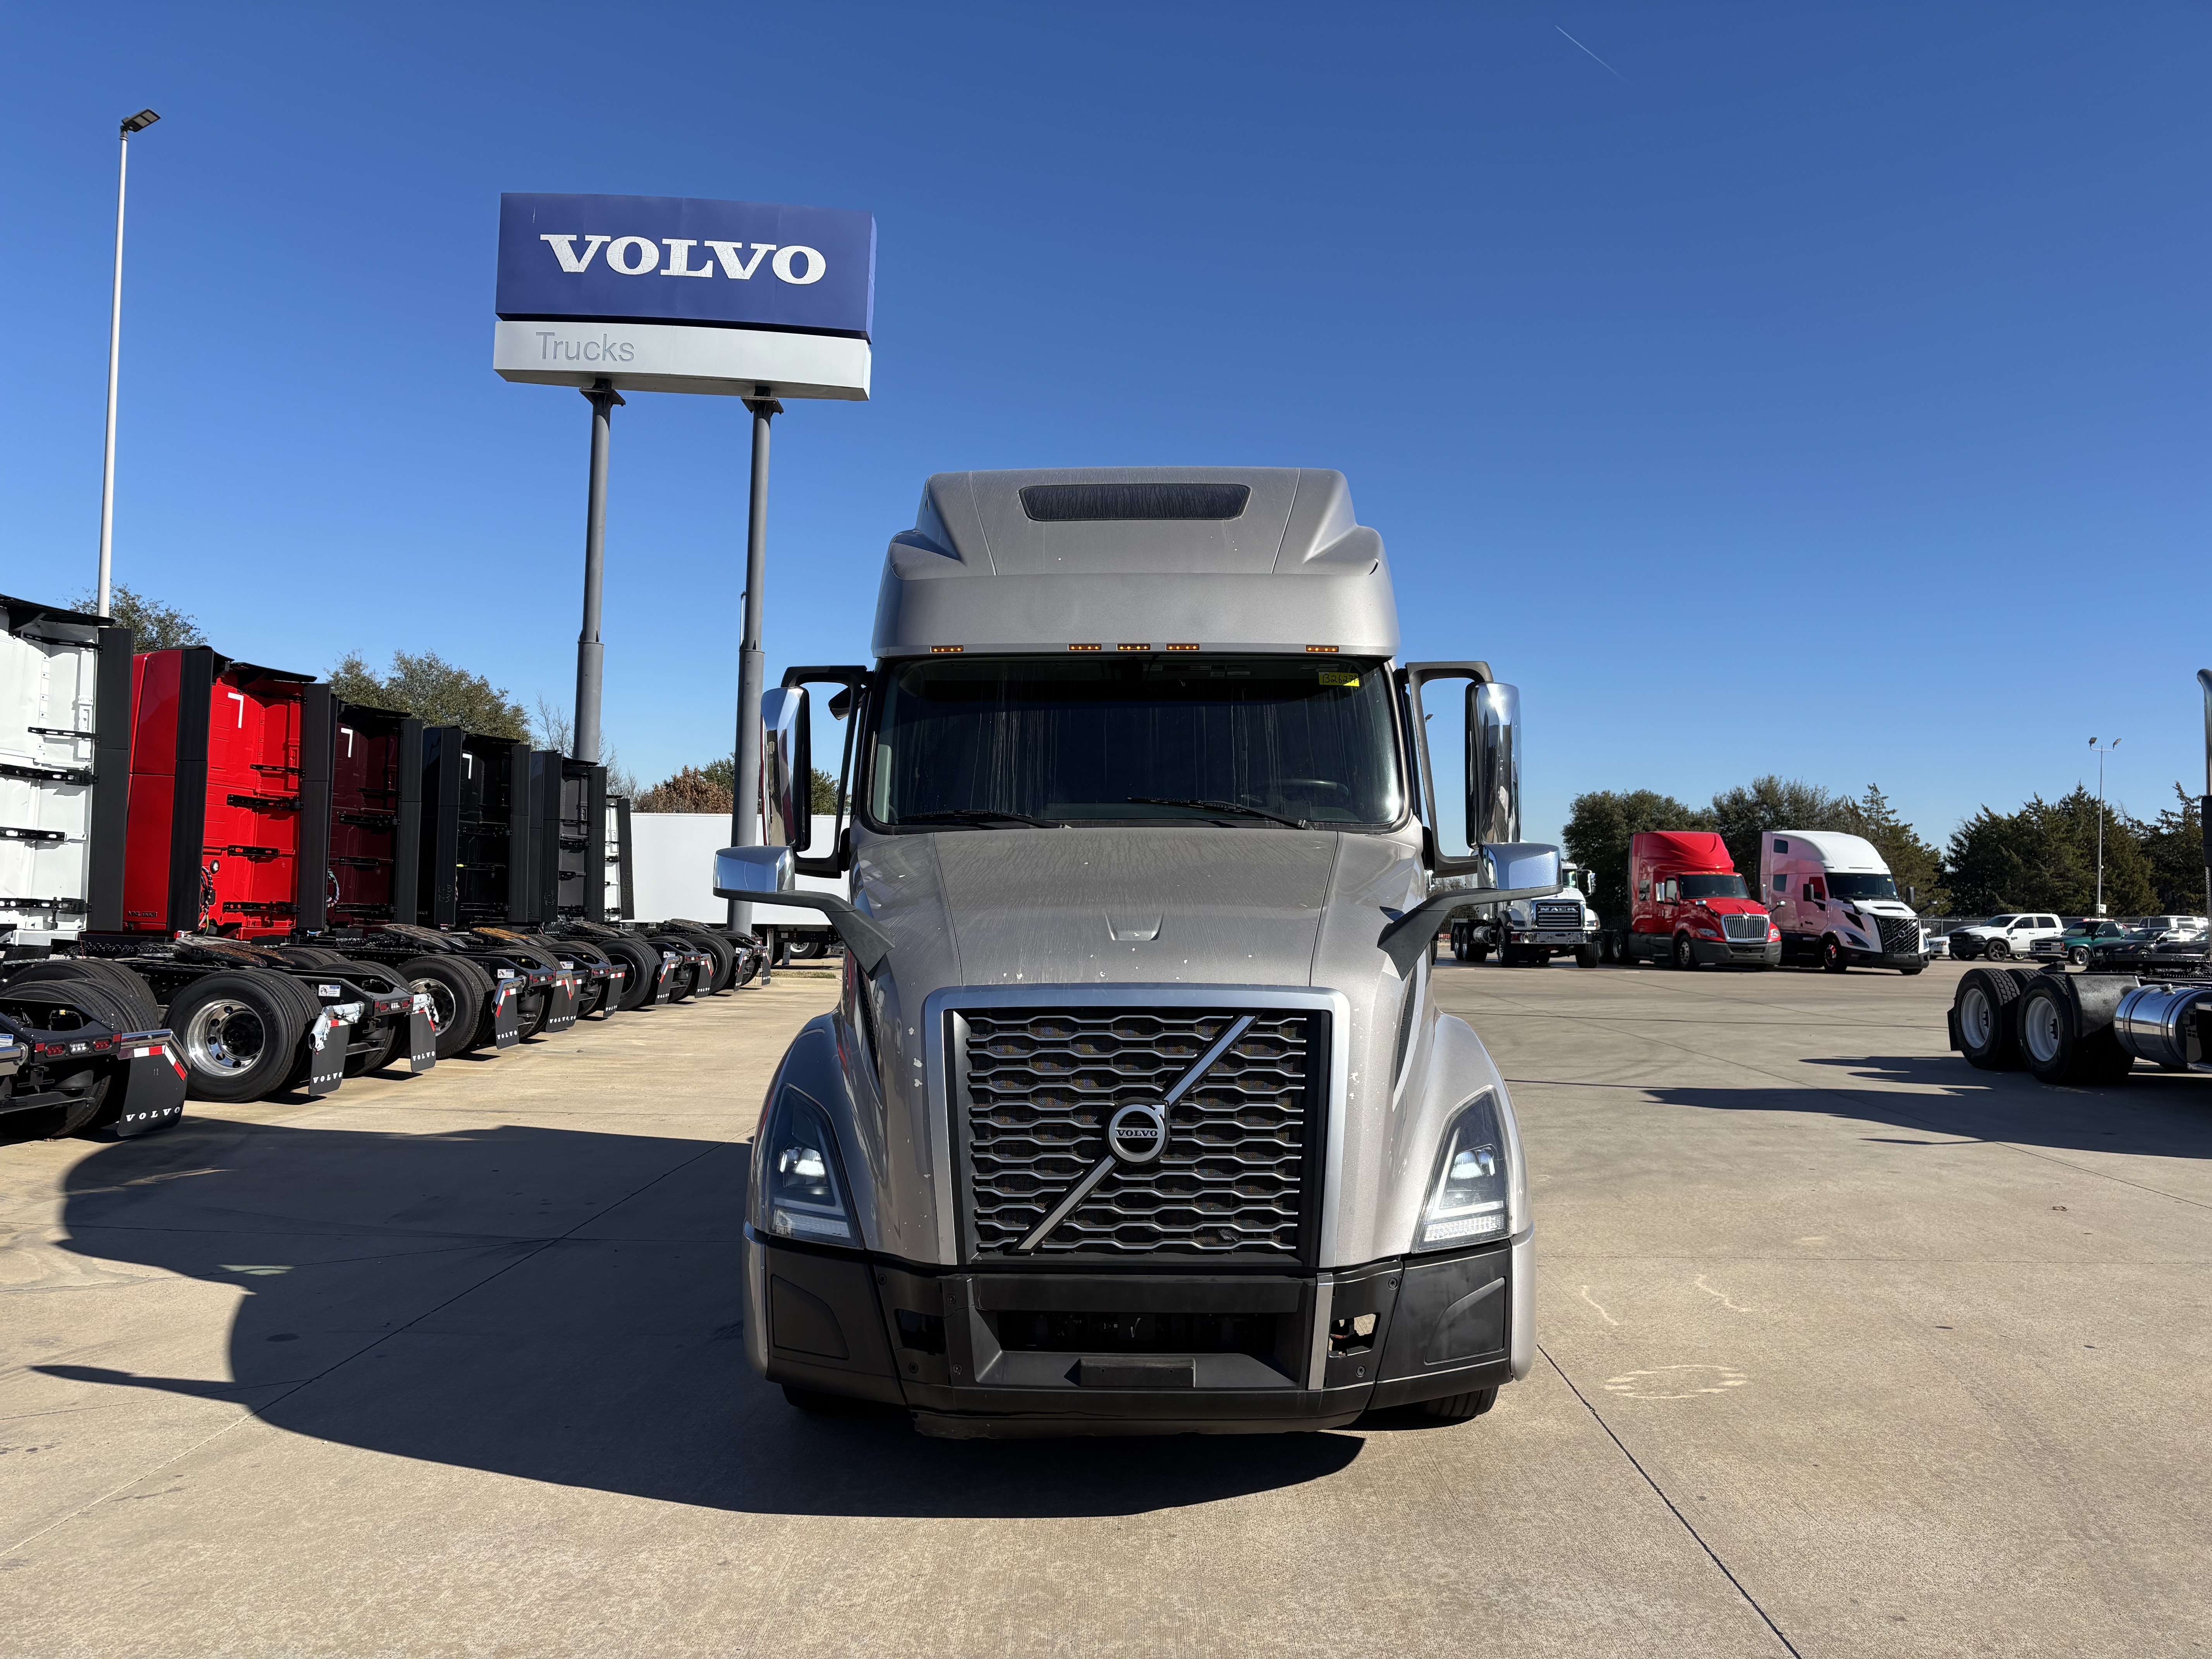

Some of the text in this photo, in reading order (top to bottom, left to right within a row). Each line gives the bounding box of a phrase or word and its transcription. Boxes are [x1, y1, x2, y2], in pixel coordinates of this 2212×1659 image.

[540, 234, 826, 285] VOLVO
[536, 331, 634, 362] Trucks
[497, 1030, 517, 1040] VOLVO
[412, 1051, 435, 1061] VOLVO
[313, 1072, 342, 1084] VOLVO
[126, 1106, 180, 1122] VOLVO
